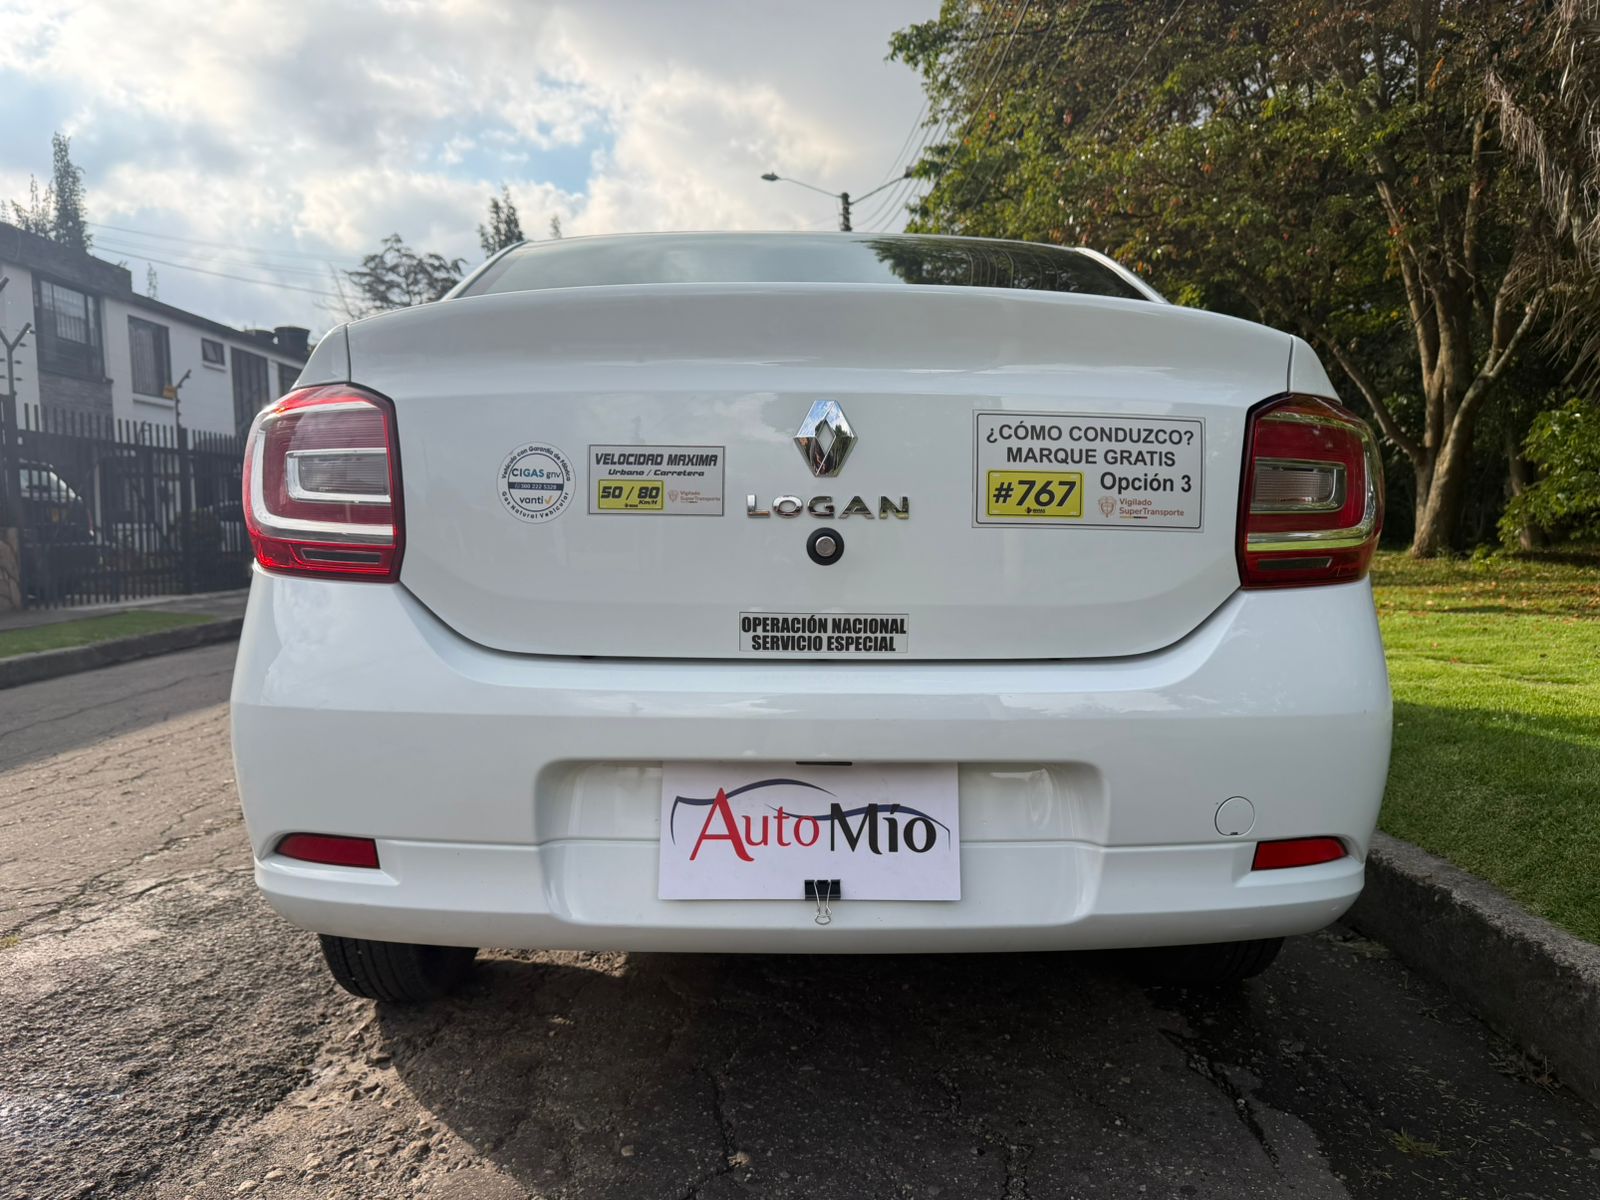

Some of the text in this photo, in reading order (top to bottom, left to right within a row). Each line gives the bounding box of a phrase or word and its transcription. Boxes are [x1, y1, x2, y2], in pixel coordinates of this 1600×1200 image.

[986, 421, 1194, 446] ¿CÓMO CONDUZCO?
[517, 448, 528, 457] con
[553, 453, 561, 461] de
[595, 453, 718, 467] VELOCIDAD MAXIMA
[1006, 447, 1176, 467] MARQUE GRATIS
[511, 468, 544, 478] CIGAS
[653, 469, 705, 477] Carretera
[1100, 472, 1192, 494] Opción 3
[519, 496, 544, 504] vanti
[600, 486, 660, 500] 50 / 80
[993, 480, 1076, 507] #767
[747, 494, 909, 519] LOGAN
[1119, 497, 1152, 507] Vigilado
[1119, 507, 1185, 517] SuperTransporte
[741, 615, 906, 634] OPERACIÓN NACIONAL
[751, 635, 896, 651] SERVICIO ESPECIAL
[689, 787, 820, 862] Auto
